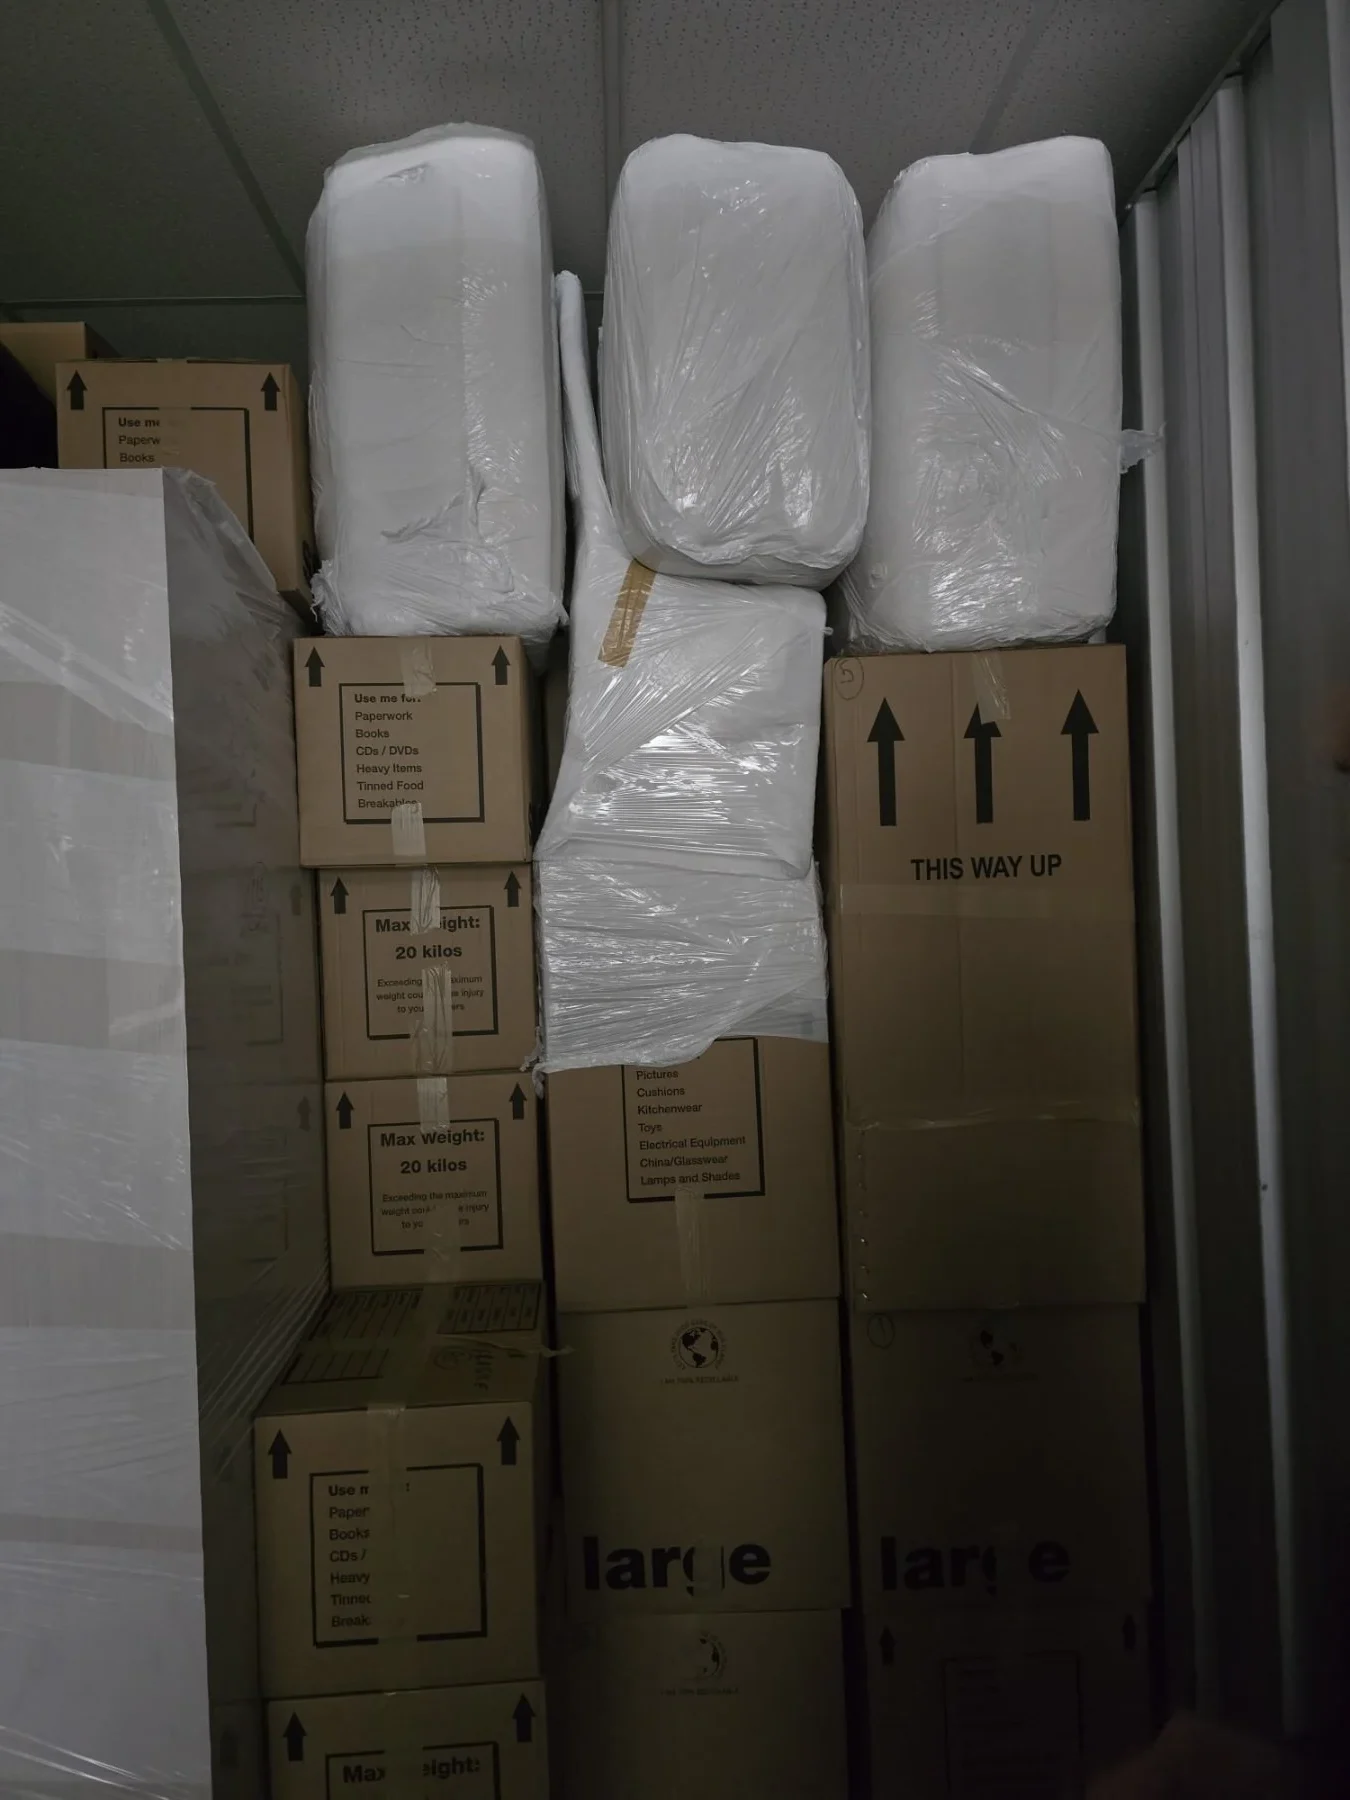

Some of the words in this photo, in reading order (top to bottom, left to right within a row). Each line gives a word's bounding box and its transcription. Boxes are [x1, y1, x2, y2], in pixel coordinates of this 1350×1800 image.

[118, 417, 141, 427] Use
[118, 435, 161, 448] Paperw
[119, 452, 155, 463] Books
[354, 693, 377, 703] Use
[380, 694, 398, 703] me
[355, 711, 413, 723] Paperwork
[355, 729, 390, 739] Books
[356, 746, 379, 756] CDs
[389, 746, 420, 756] DVDs
[356, 764, 391, 776] Heavy
[393, 763, 423, 774] Items
[356, 781, 394, 791] Tinned
[396, 780, 424, 791] Food
[910, 857, 964, 881] THIS
[970, 855, 1023, 879] WAY
[1030, 853, 1062, 877] UP
[375, 918, 411, 933] Max
[395, 946, 418, 960] 20
[422, 944, 463, 959] kilos
[377, 978, 422, 988] Exceeding
[376, 993, 405, 1002] weight
[636, 1070, 679, 1081] Pictures
[636, 1087, 686, 1098] Cushions
[637, 1104, 702, 1115] Kitchenwear
[637, 1123, 664, 1134] Toys
[380, 1132, 416, 1147] Max
[421, 1128, 486, 1146] Weight:
[640, 1139, 687, 1151] Electrical
[690, 1136, 746, 1150] Equipment
[400, 1160, 422, 1174] 20
[427, 1158, 468, 1173] kilos
[640, 1155, 729, 1168] China/Glasswear
[640, 1176, 676, 1187] Lamps
[679, 1174, 700, 1184] and
[702, 1171, 741, 1182] Shades
[382, 1192, 428, 1203] Exceeding
[429, 1191, 443, 1200] the
[445, 1189, 487, 1200] maximum
[381, 1207, 410, 1217] weight
[328, 1484, 356, 1497] Use
[329, 1507, 370, 1520] Paper
[329, 1528, 371, 1541] Books
[329, 1550, 359, 1562] CDs
[330, 1572, 371, 1585] Heavy
